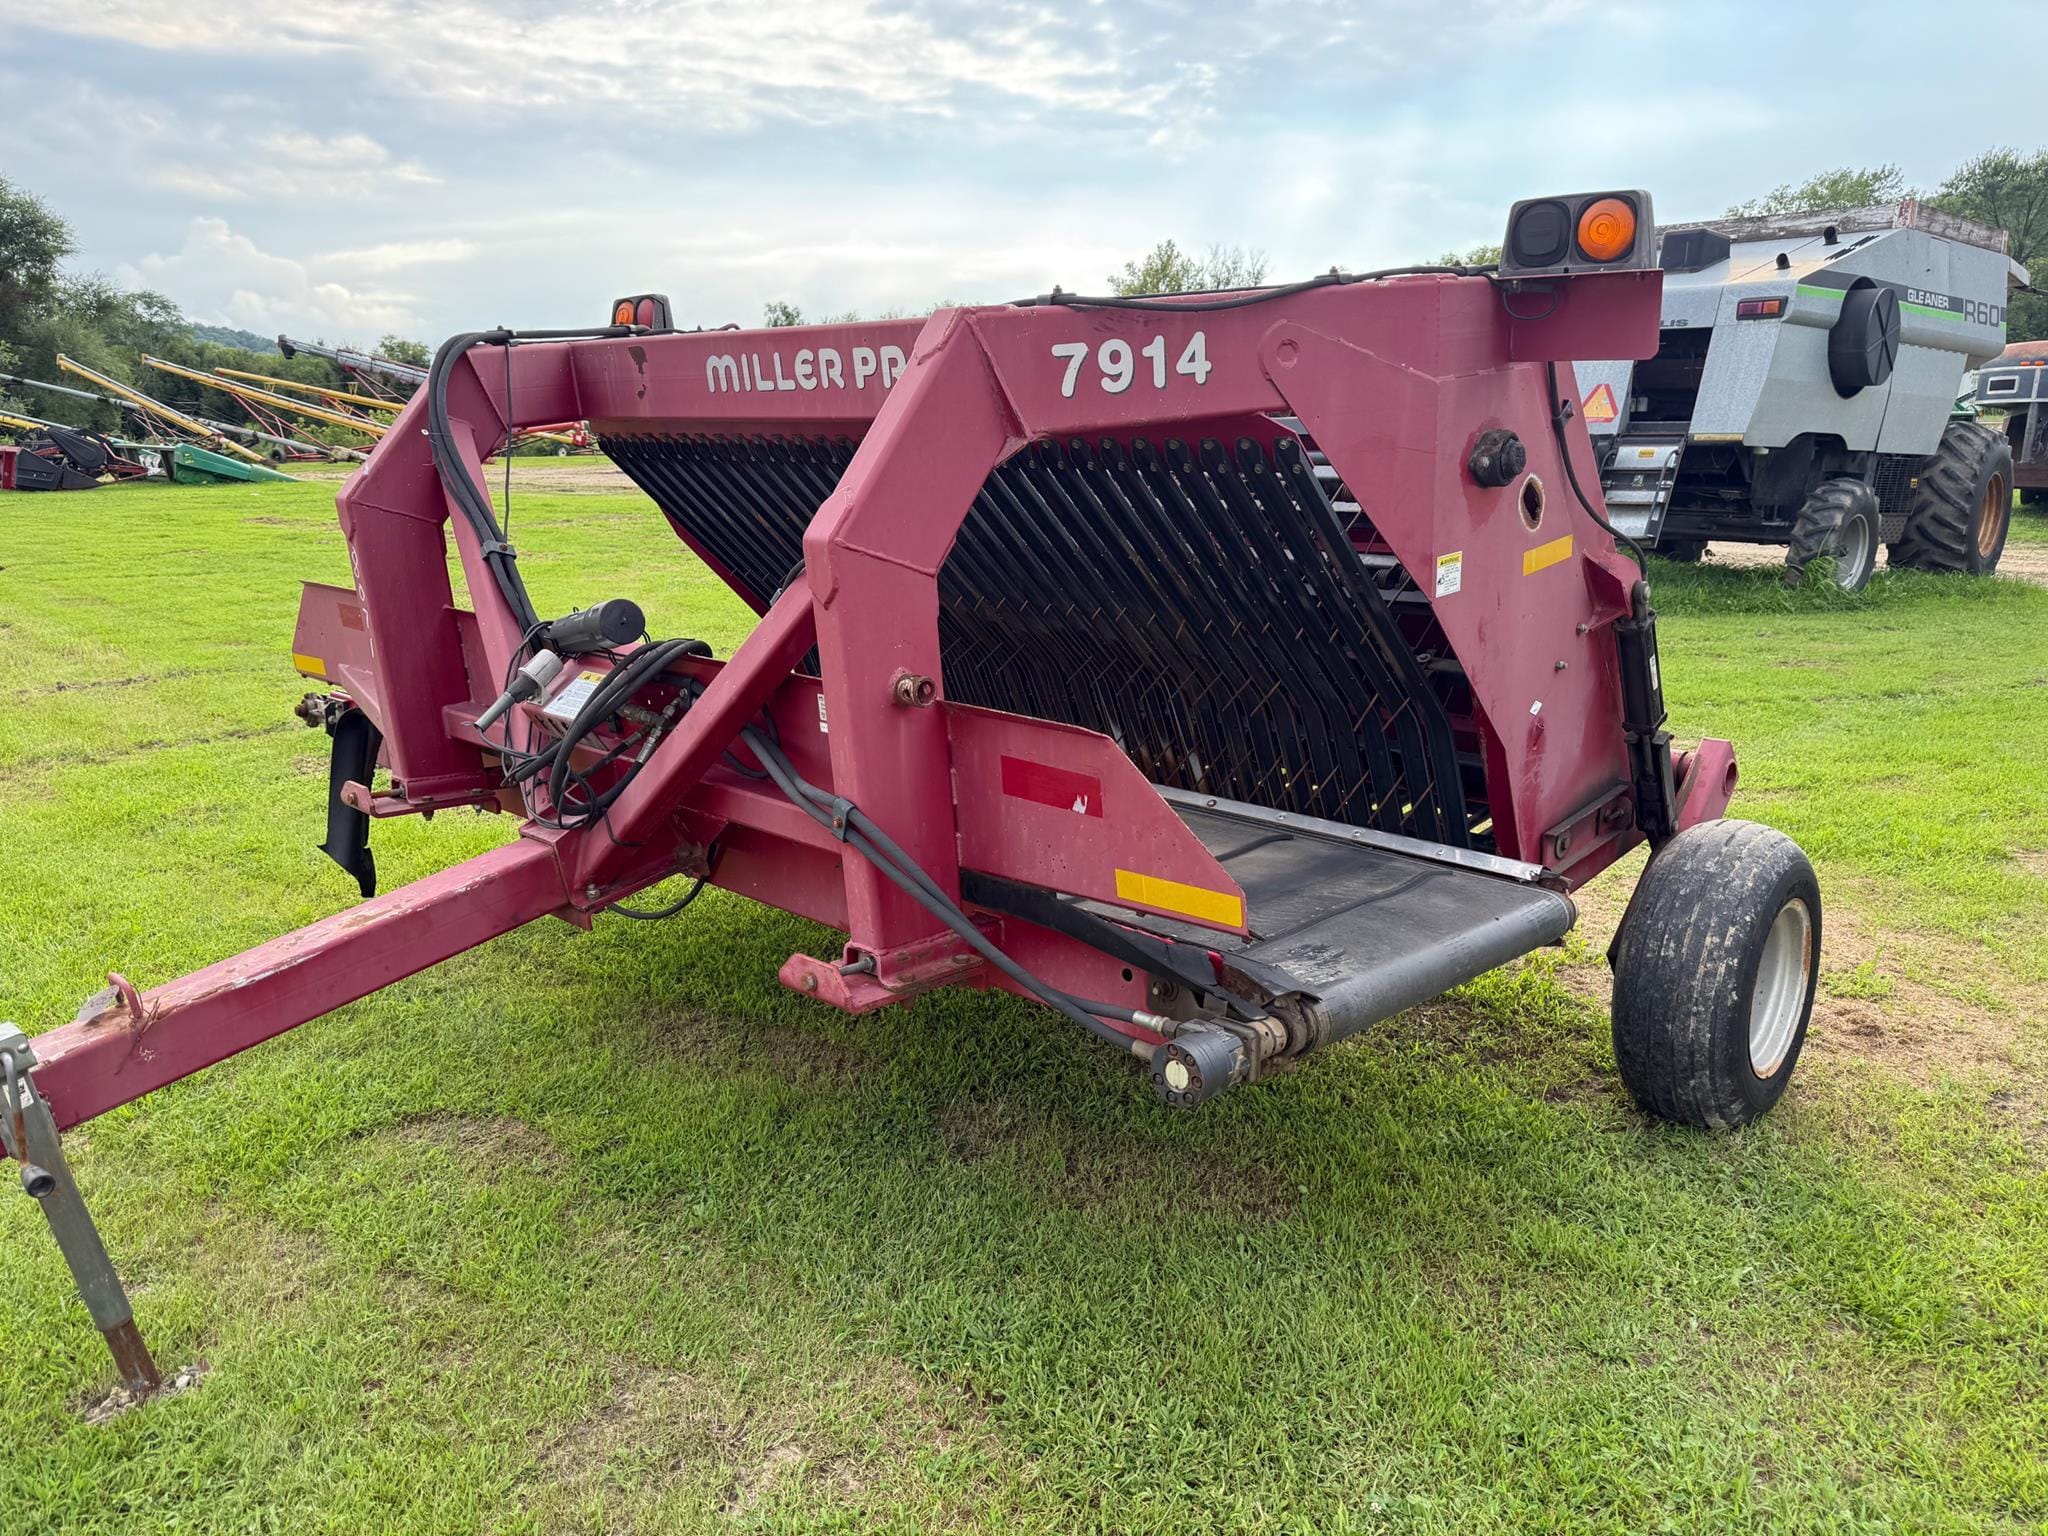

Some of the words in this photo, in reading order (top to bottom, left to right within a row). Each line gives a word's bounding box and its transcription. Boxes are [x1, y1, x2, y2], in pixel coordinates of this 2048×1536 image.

[1907, 288, 1949, 309] GLEANER
[1964, 299, 2000, 328] R60
[706, 348, 846, 393] MILLER
[1051, 331, 1213, 397] 7914
